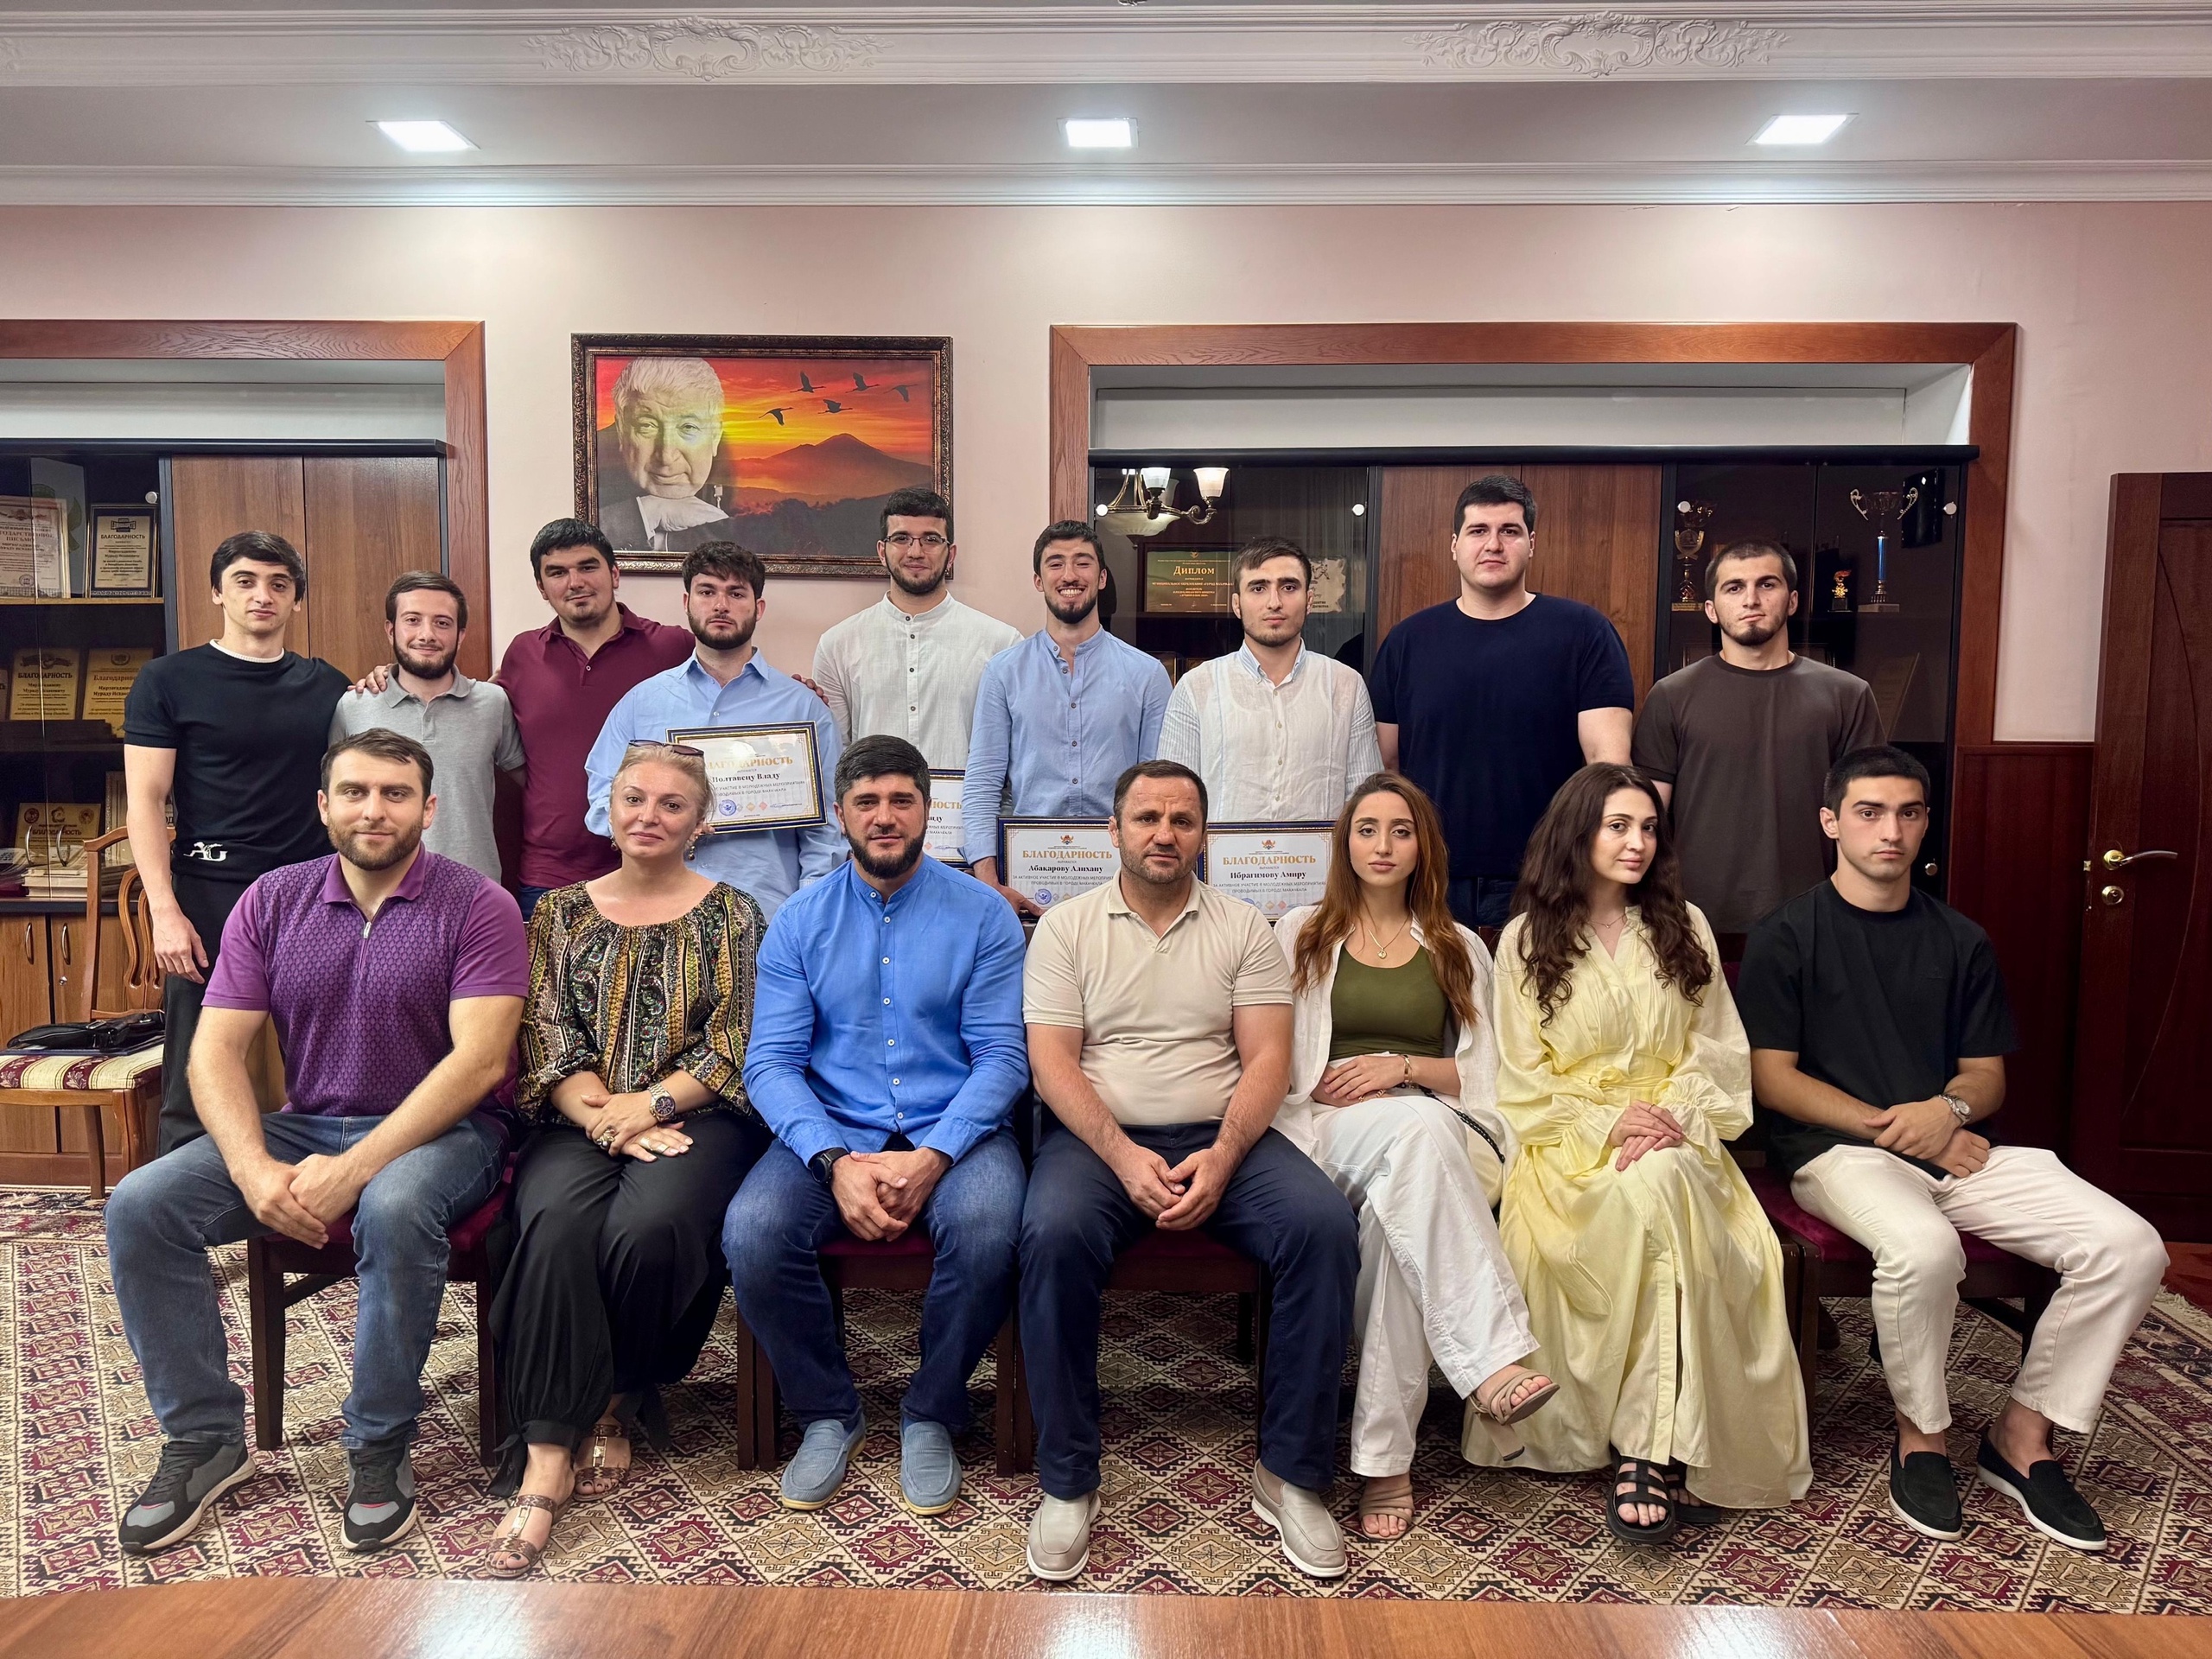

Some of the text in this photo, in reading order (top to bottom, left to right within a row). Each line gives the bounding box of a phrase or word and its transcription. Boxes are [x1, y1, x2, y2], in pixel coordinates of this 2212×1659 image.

[1173, 565, 1215, 576] Диплом
[1022, 850, 1112, 860] БЛАГОДАРНОСТЬ
[1223, 855, 1317, 867] БЛАГОДАРНОСТЬ
[1028, 865, 1070, 874] Абакарову
[1230, 871, 1306, 880] Ибрагимову Амиру
